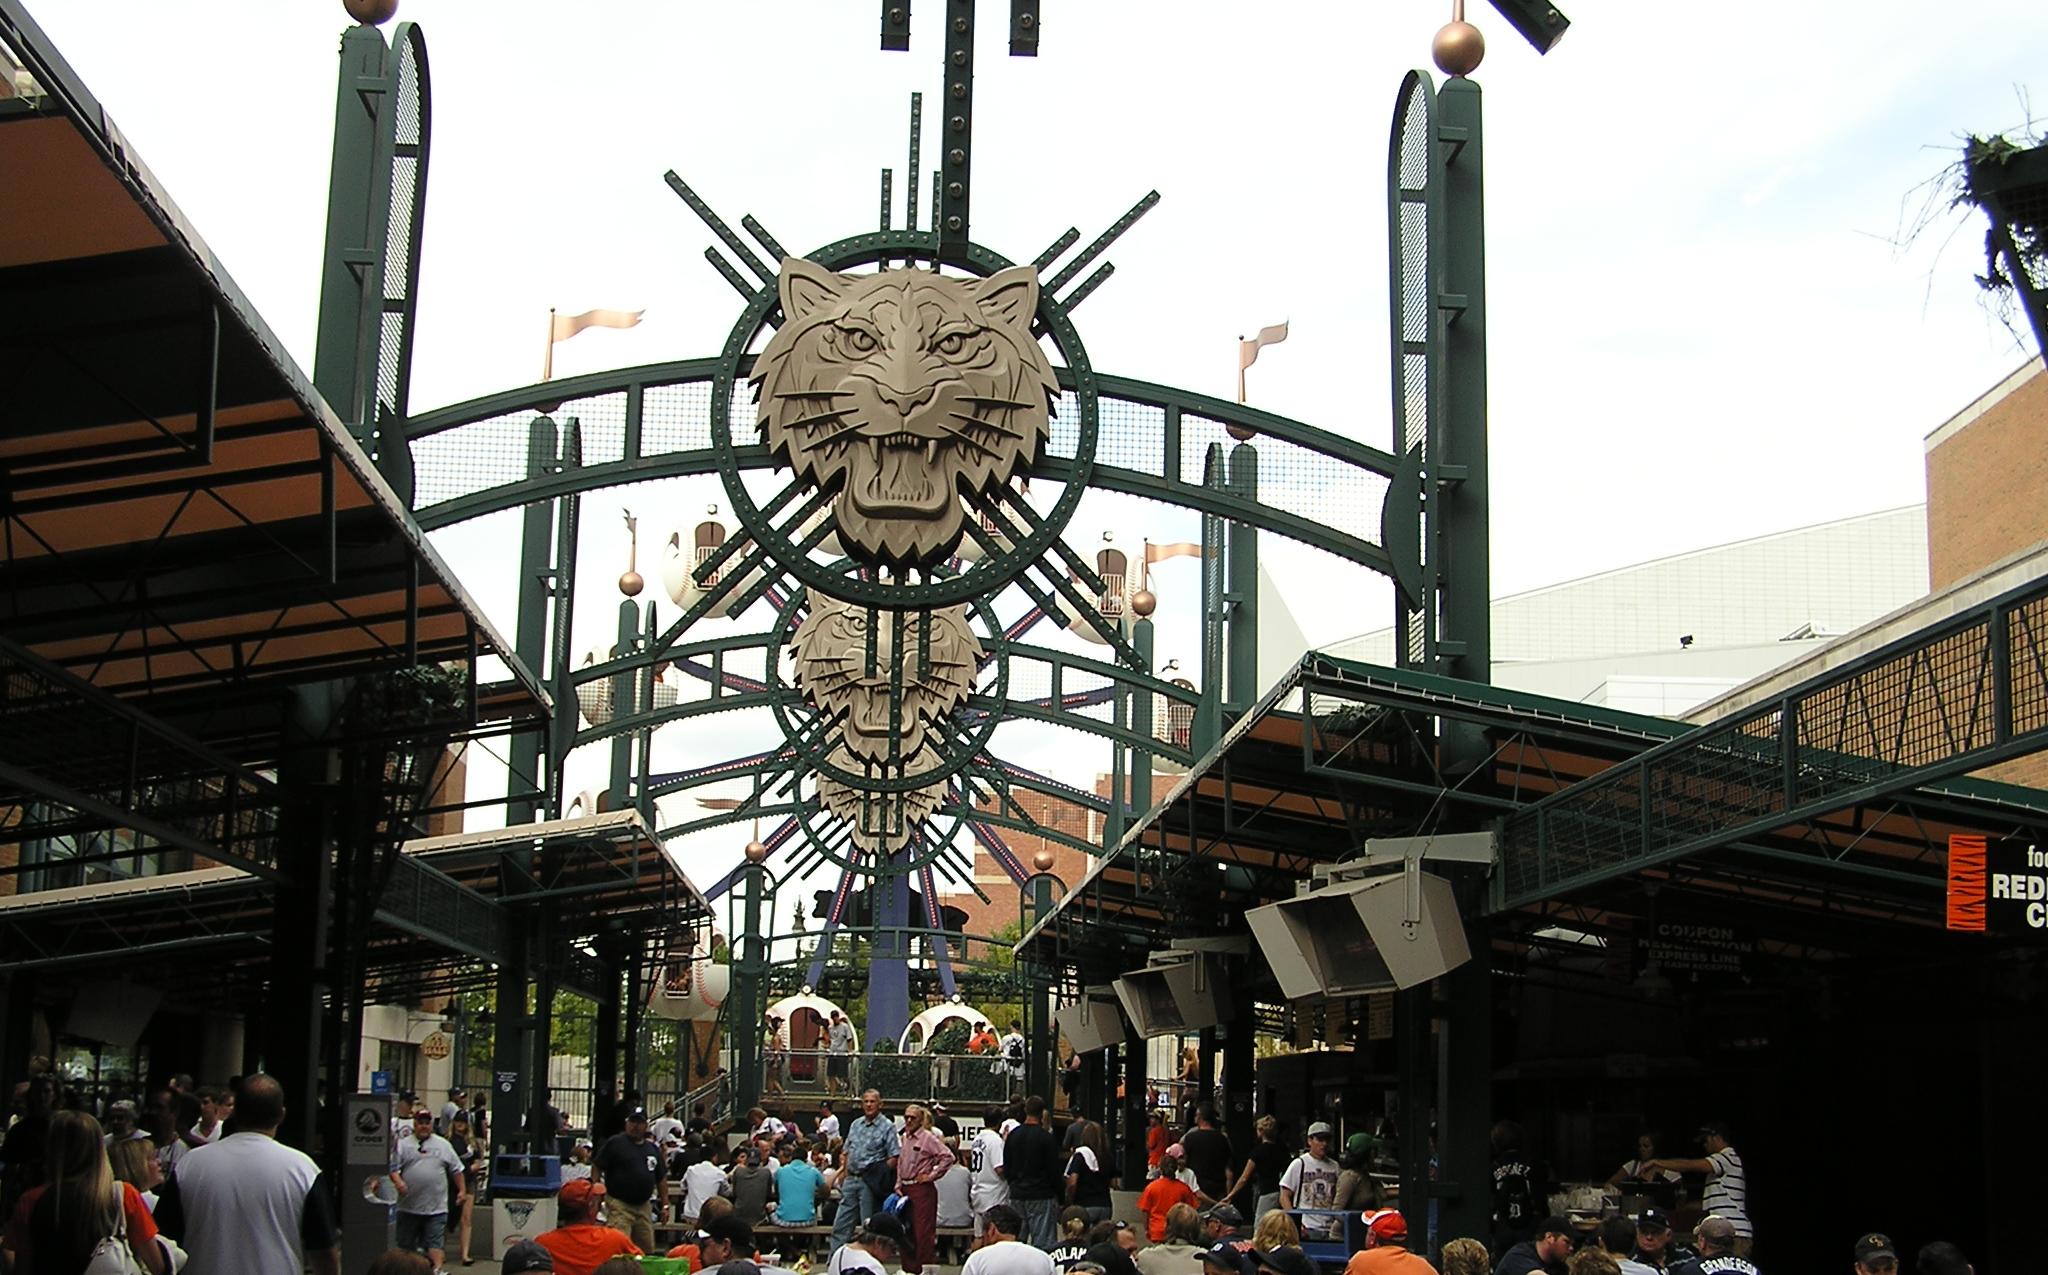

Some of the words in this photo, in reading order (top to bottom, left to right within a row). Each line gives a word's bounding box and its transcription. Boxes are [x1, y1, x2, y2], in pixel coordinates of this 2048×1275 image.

[1992, 873, 2048, 901] RED
[2026, 902, 2048, 929] C
[1657, 923, 1734, 941] COUPON
[1648, 949, 1708, 963] EXPRESS
[1711, 952, 1742, 966] LINE
